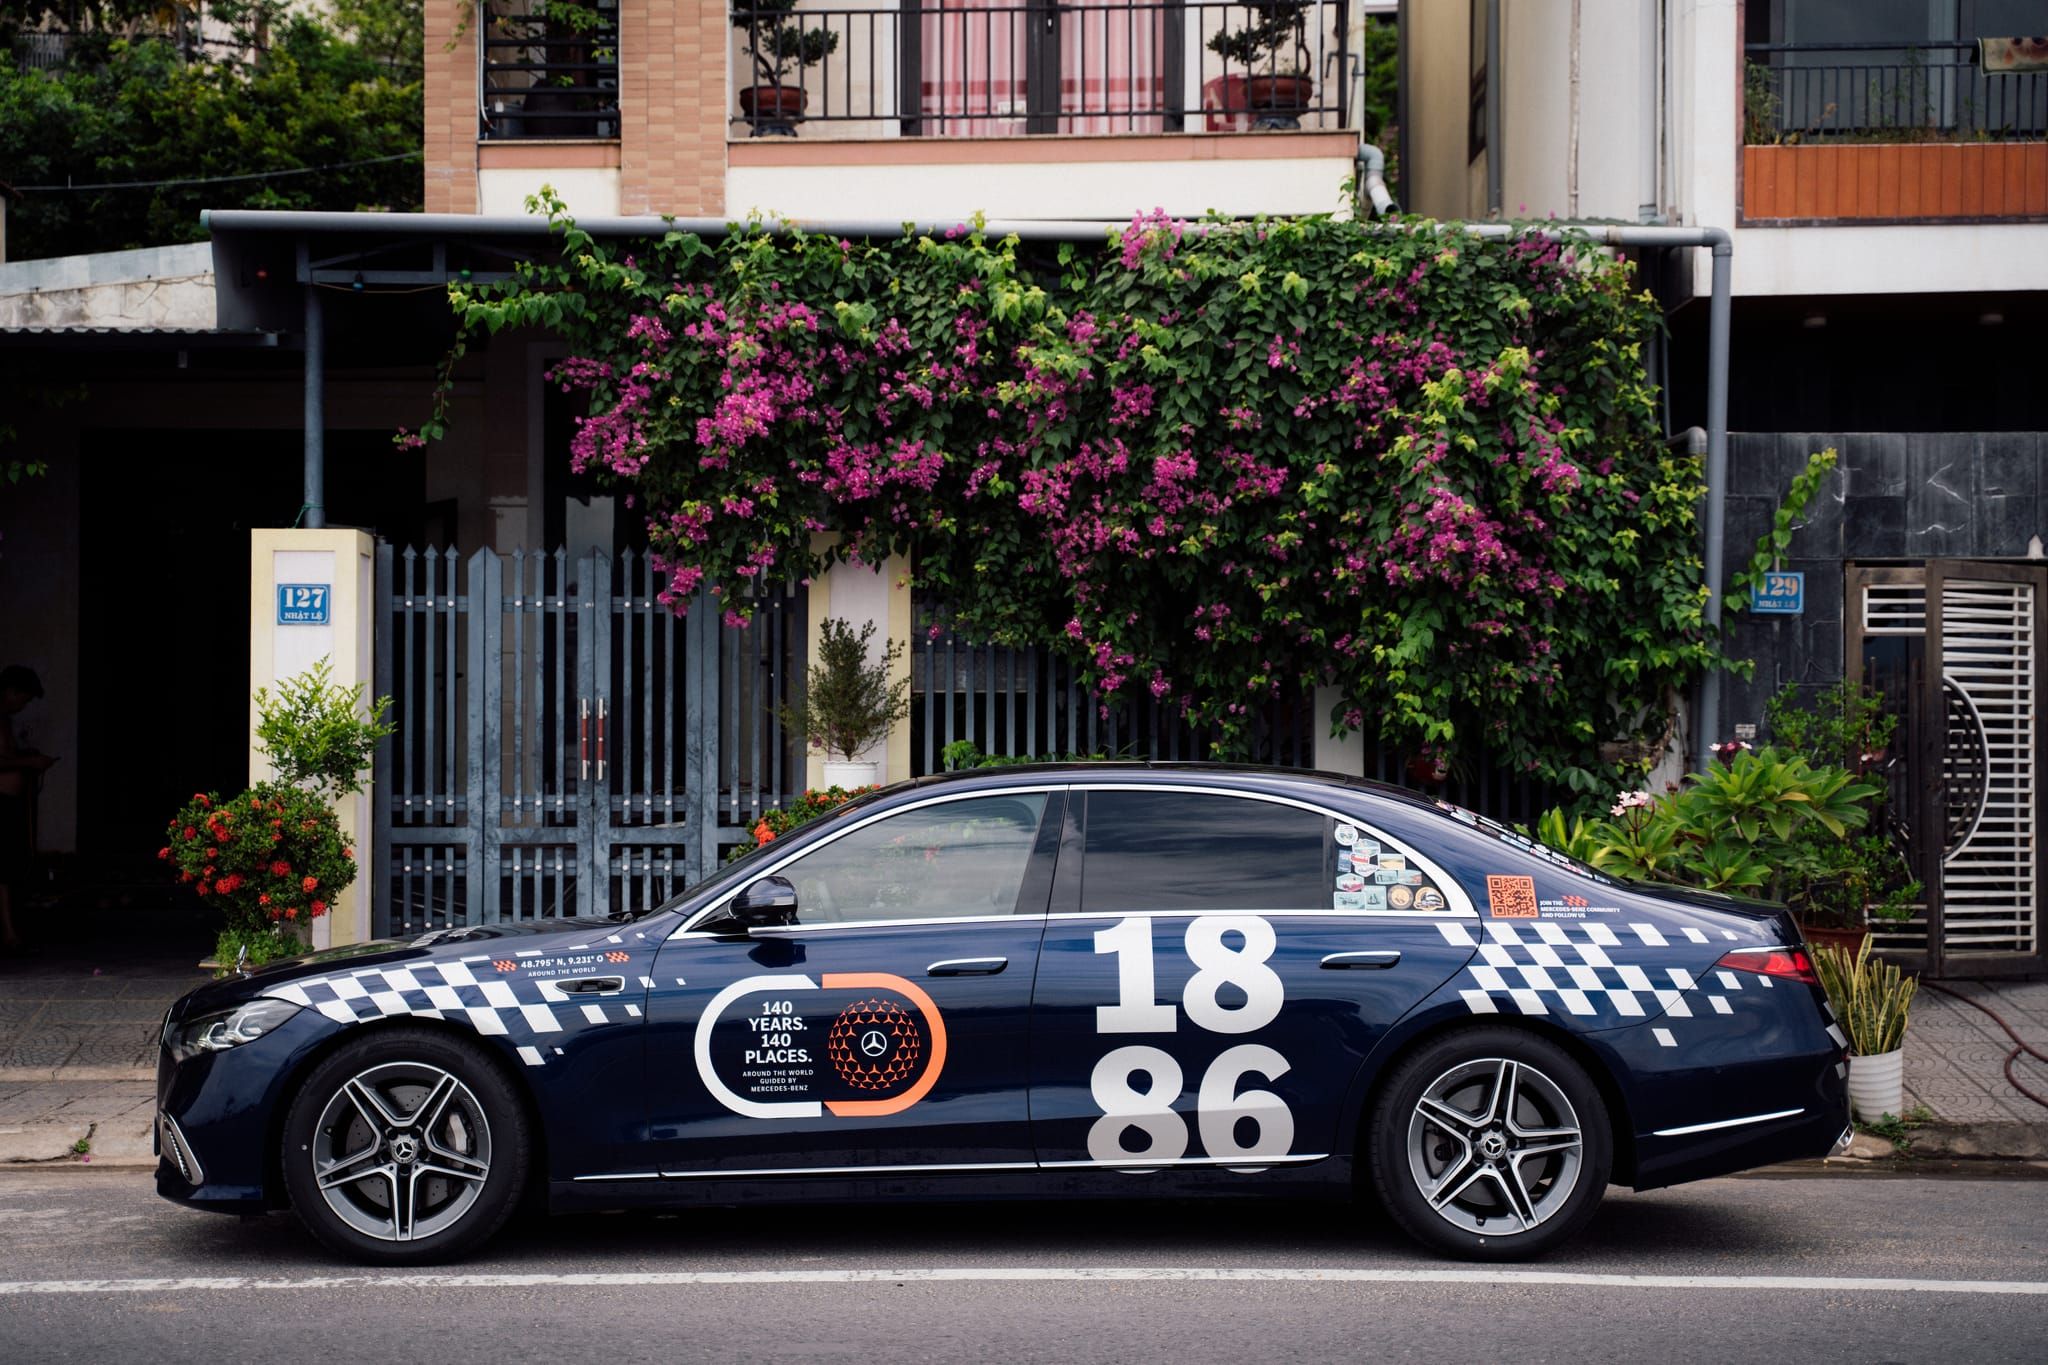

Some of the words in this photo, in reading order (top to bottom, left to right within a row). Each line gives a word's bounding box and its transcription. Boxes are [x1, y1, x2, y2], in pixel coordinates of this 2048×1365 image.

[285, 588, 325, 608] 127
[521, 958, 555, 969] 48.795°
[556, 958, 566, 967] N,
[568, 955, 595, 965] 9.231°
[528, 970, 556, 978] AROUND
[558, 968, 570, 976] THE
[572, 966, 596, 974] WORLD
[1093, 915, 1284, 1034] 18
[762, 1000, 793, 1015] 140
[748, 1016, 808, 1032] YEARS.
[761, 1033, 792, 1048] 140
[745, 1048, 813, 1064] PLACES.
[750, 1084, 809, 1093] MERCEDES-BENZ
[1087, 1043, 1294, 1174] 86
